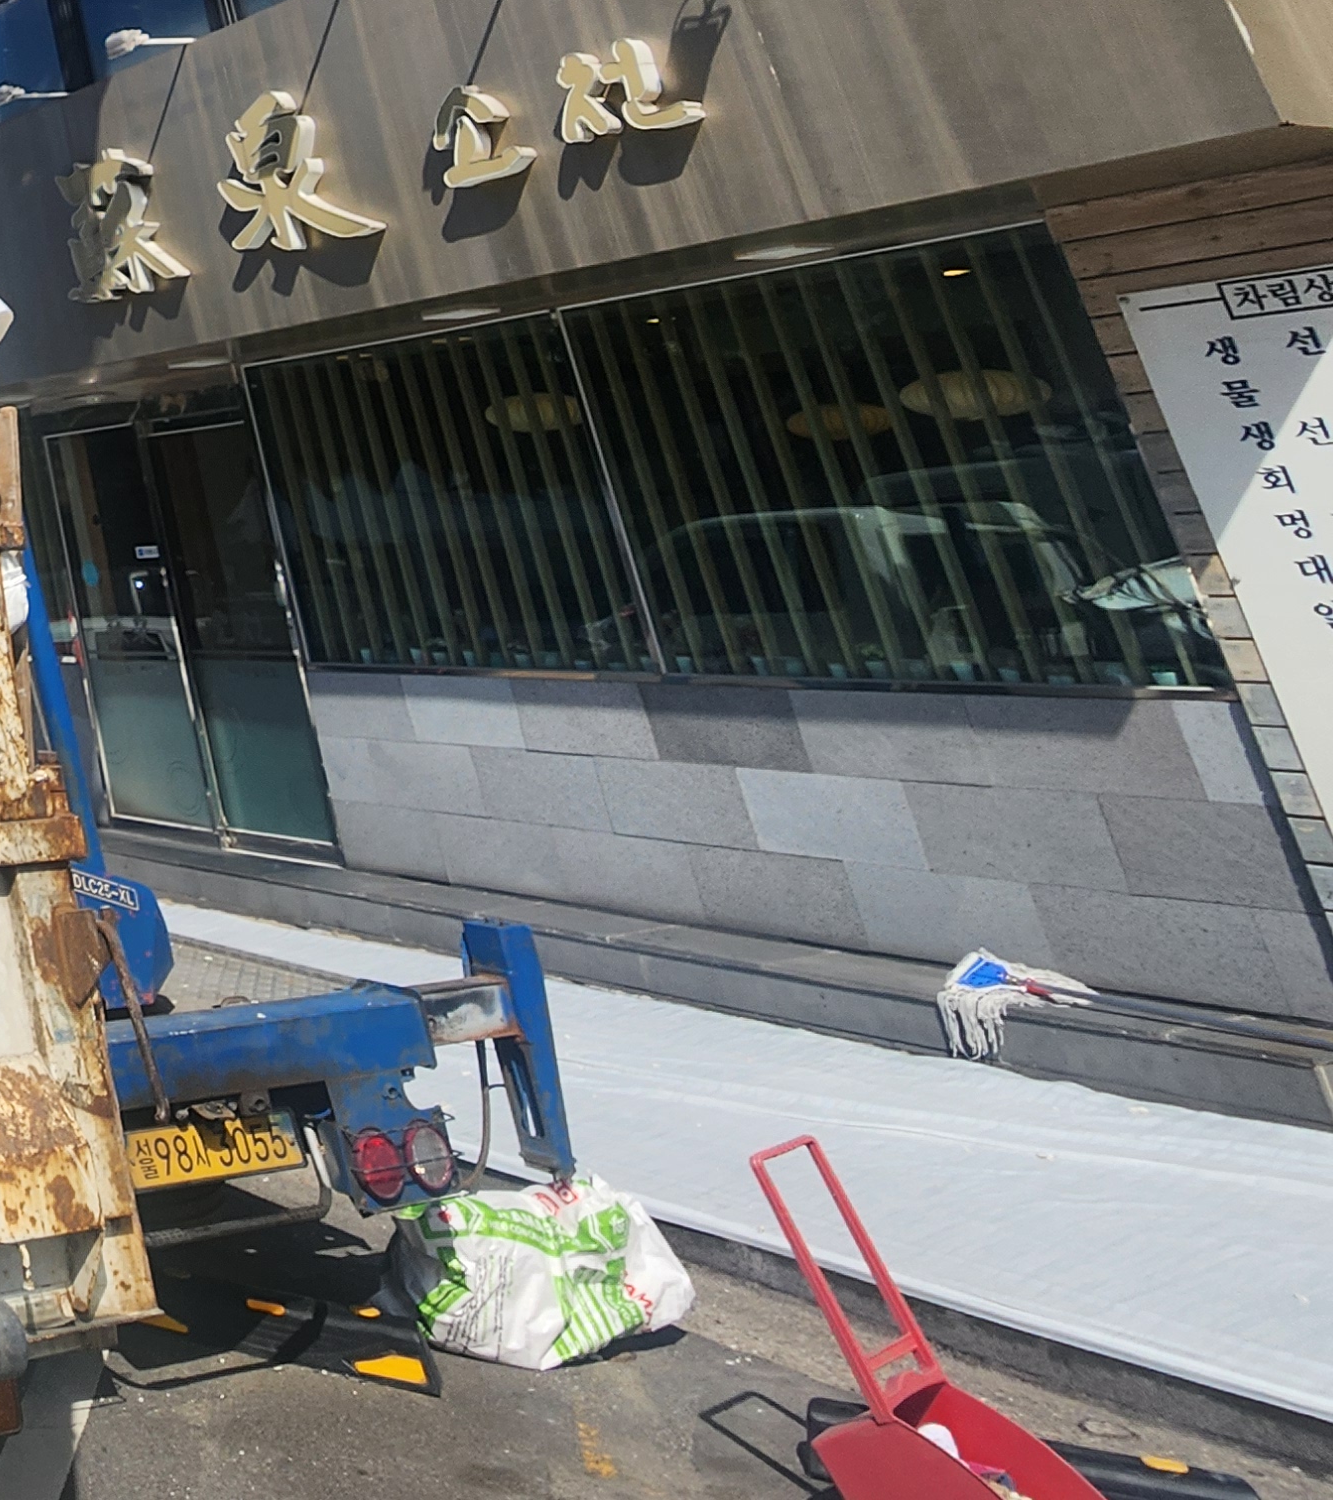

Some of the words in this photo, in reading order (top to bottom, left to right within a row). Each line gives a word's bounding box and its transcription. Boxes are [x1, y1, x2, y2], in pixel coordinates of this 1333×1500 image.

[1220, 379, 1261, 408] 물
[1256, 464, 1296, 494] 회
[1274, 509, 1313, 539] 멍
[72, 872, 136, 907] DLC25-XL
[134, 1138, 160, 1180] 서울
